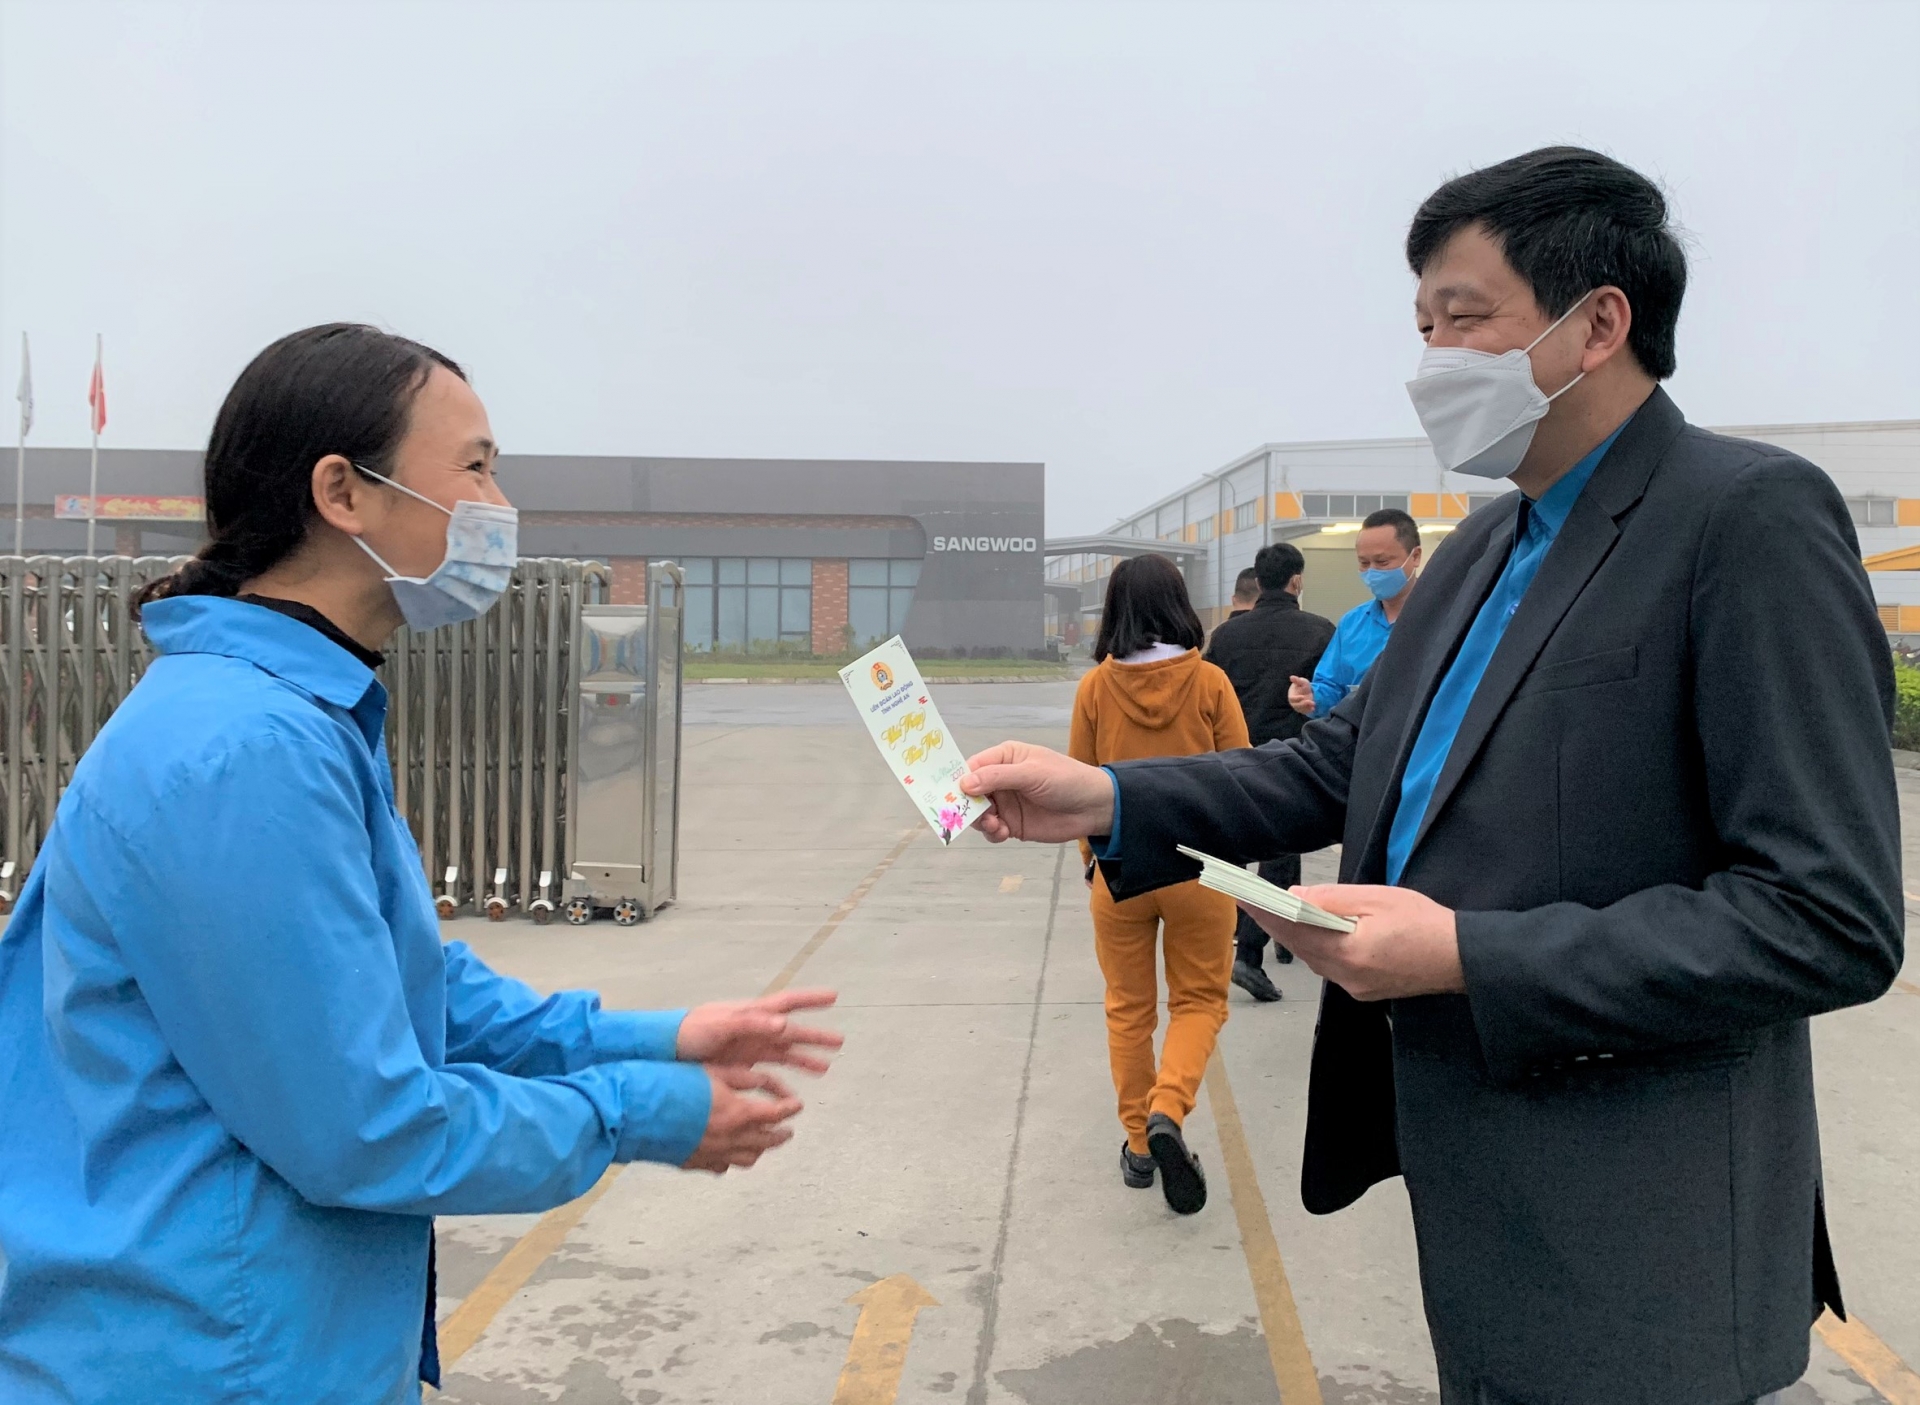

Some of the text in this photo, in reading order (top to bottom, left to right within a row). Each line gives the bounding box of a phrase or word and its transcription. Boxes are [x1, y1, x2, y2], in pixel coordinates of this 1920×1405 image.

[933, 536, 1036, 552] SANGWOO
[892, 689, 901, 698] LAO
[903, 693, 910, 701] AN
